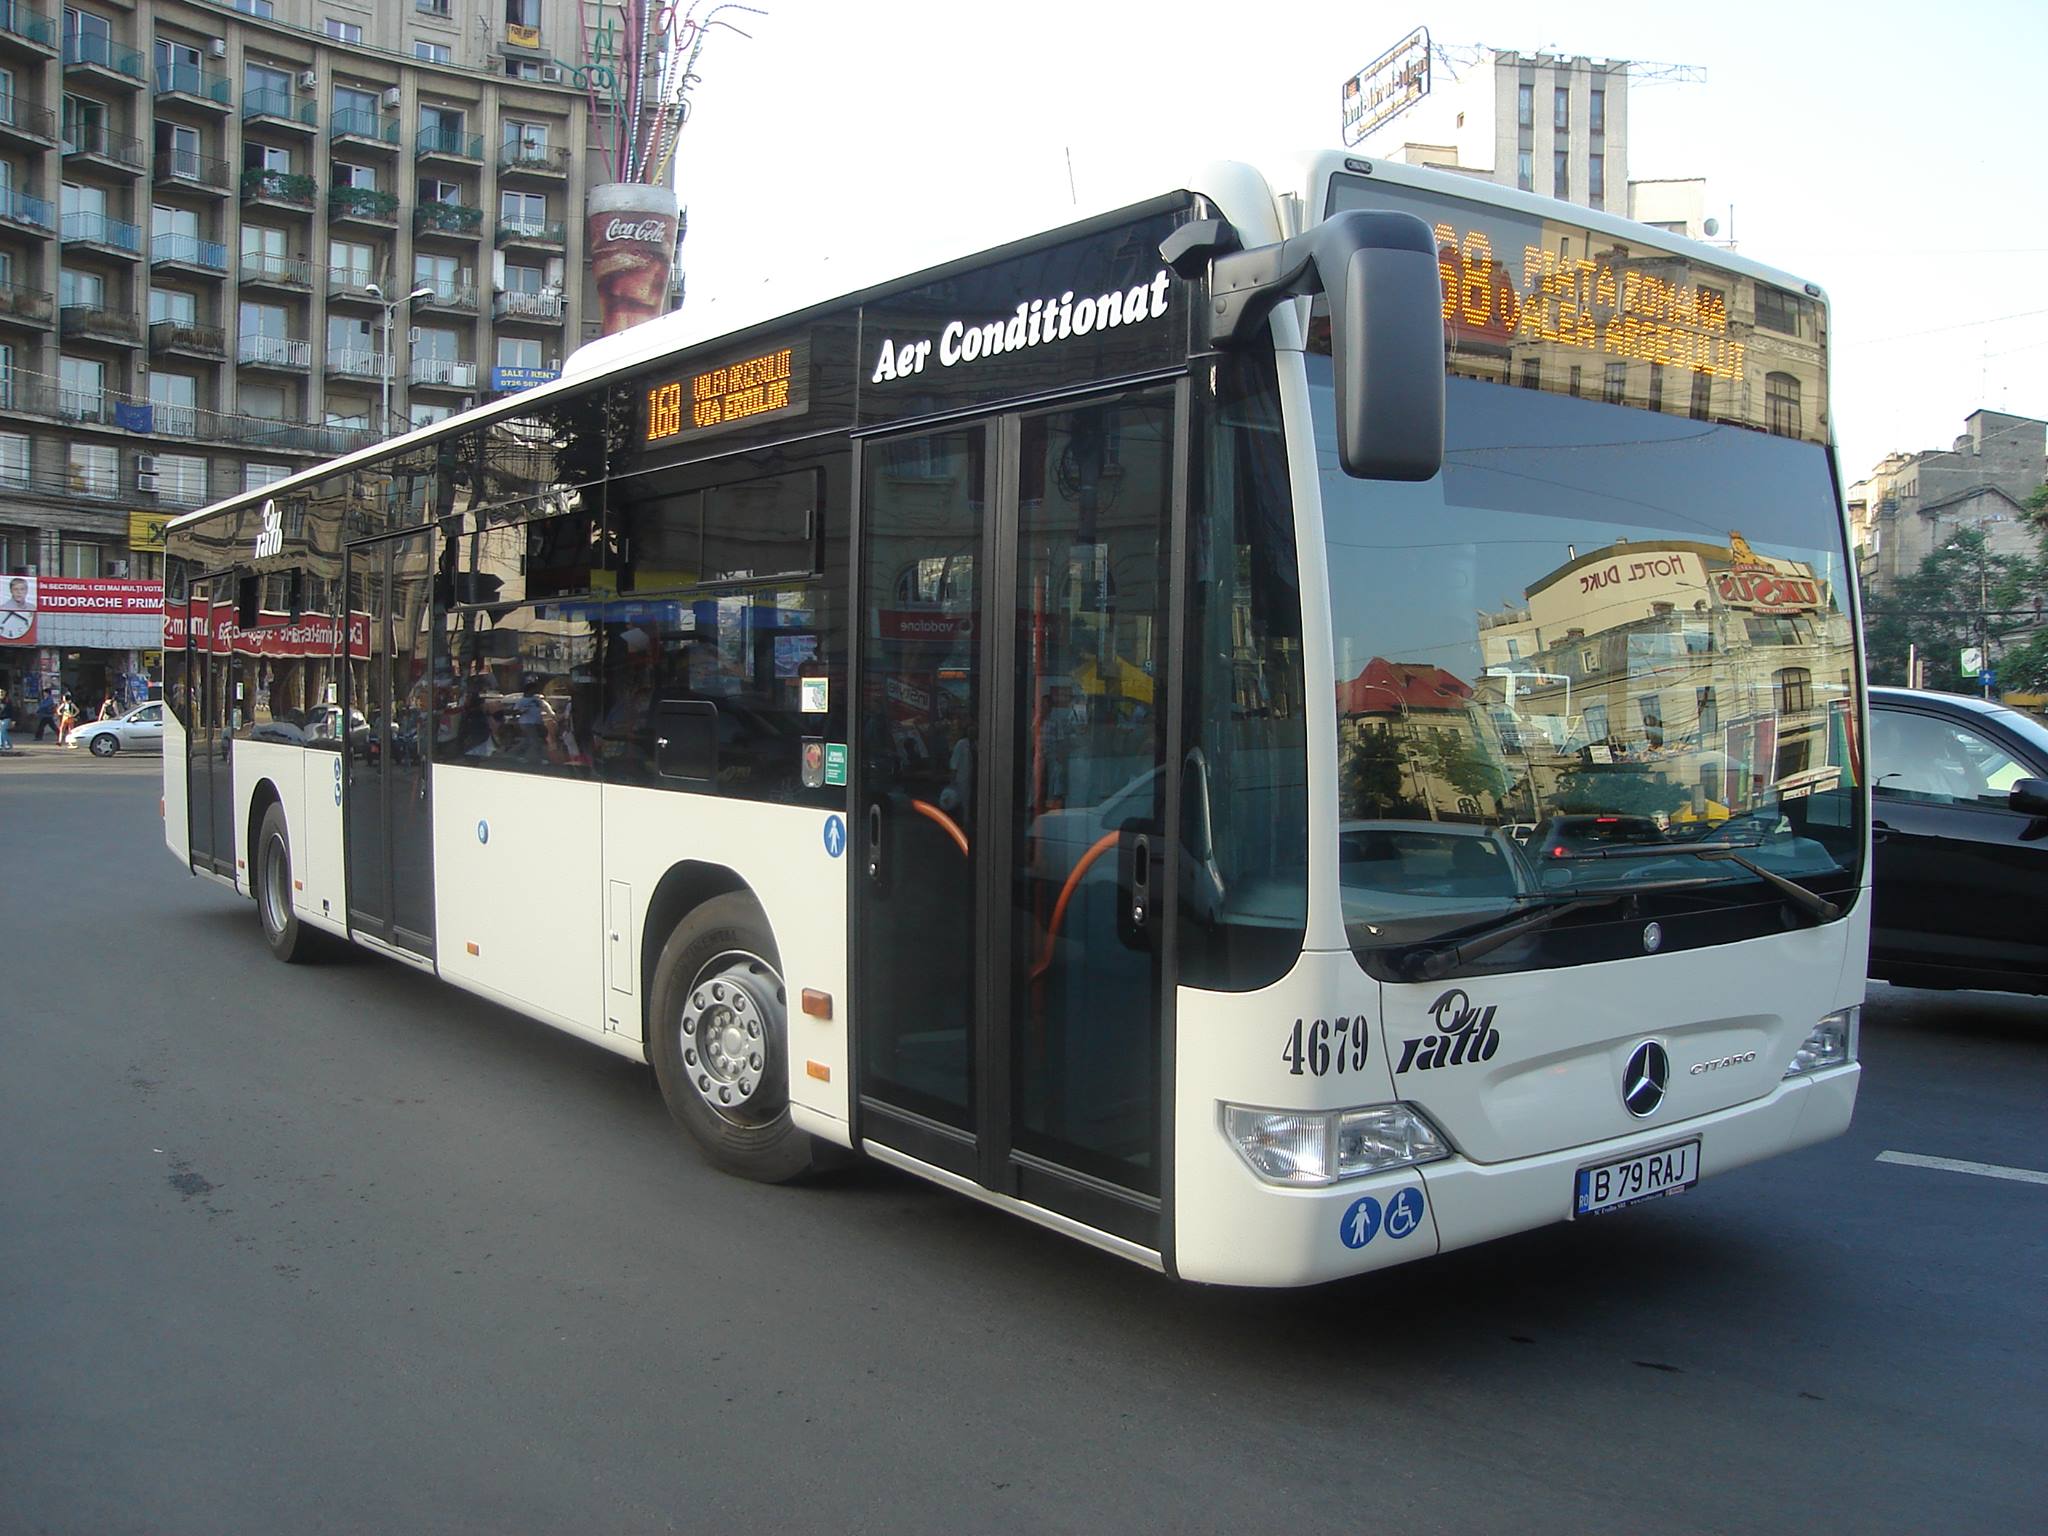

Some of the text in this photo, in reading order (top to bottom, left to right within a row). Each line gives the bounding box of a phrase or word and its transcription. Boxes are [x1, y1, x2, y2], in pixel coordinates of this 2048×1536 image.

[606, 218, 666, 242] Coca-Cola
[872, 269, 1170, 383] Aer Conditionat
[1625, 270, 1726, 335] ROMANA
[1500, 287, 1745, 381] VALEA ARGESULUI
[501, 369, 524, 377] SALE
[531, 370, 556, 379] RENT
[694, 368, 728, 401] VALEA
[647, 383, 681, 441] 168
[694, 380, 789, 428] VIA EROILOR
[40, 596, 122, 608] TUDORACHE
[1282, 1015, 1369, 1077] 4679
[1690, 1050, 1756, 1075] CITARO
[1595, 1150, 1686, 1202] B 79 RAJ
[1579, 1193, 1589, 1208] RO
